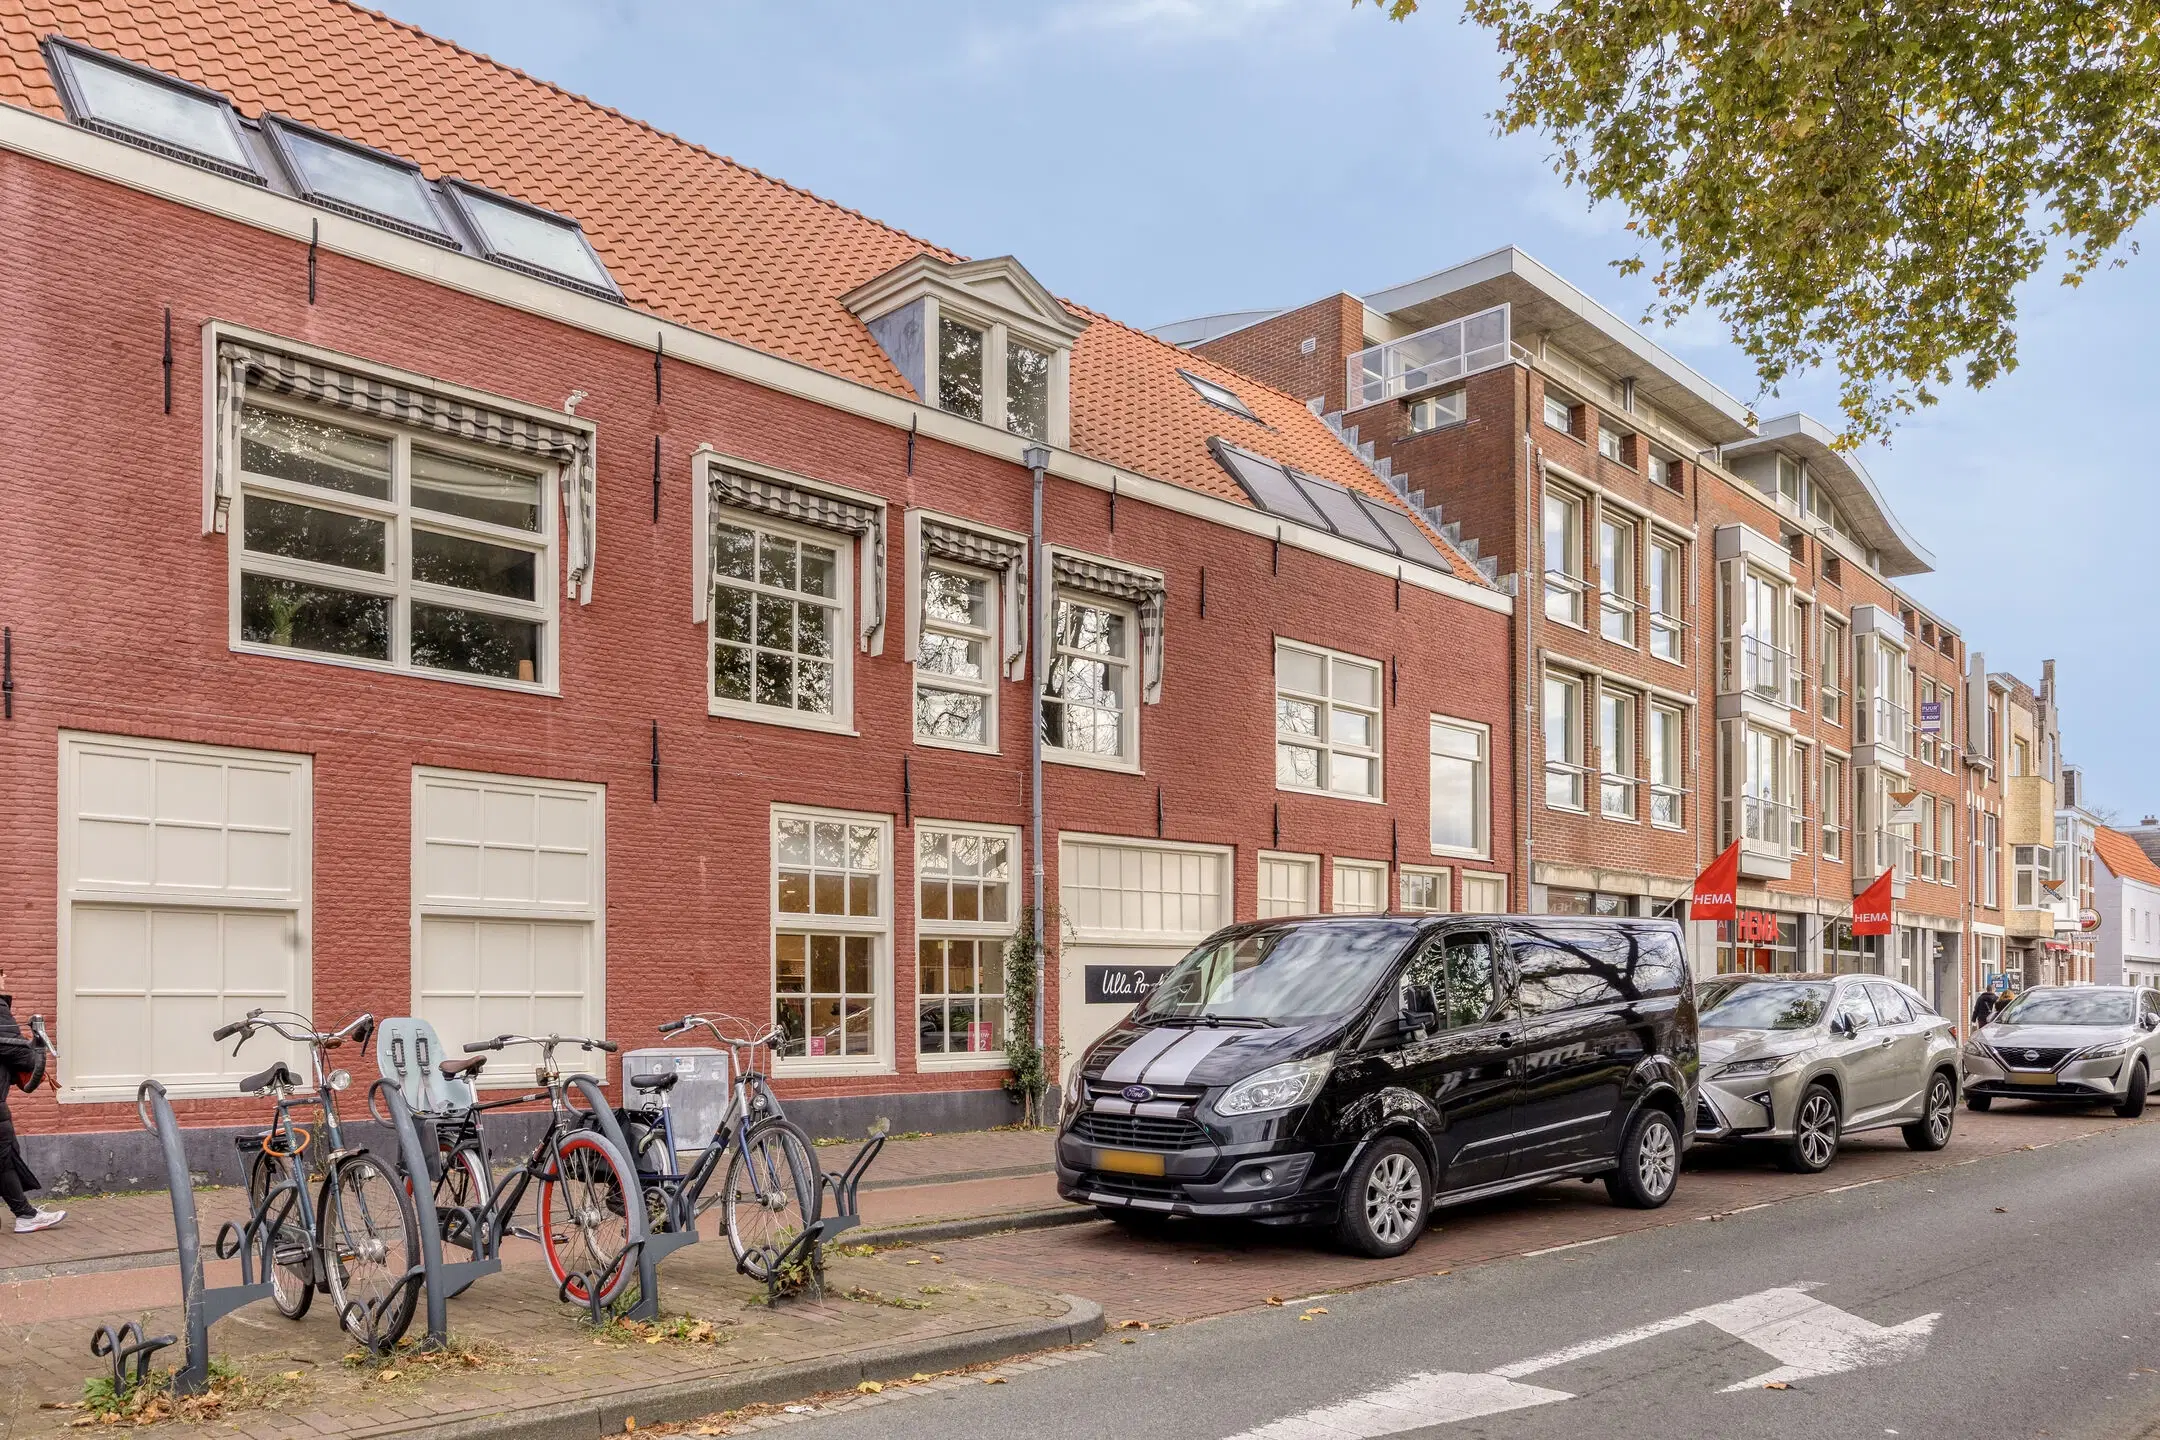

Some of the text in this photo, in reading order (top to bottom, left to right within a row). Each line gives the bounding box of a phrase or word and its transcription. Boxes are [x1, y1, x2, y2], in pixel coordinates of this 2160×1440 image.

[1693, 893, 1733, 905] HEMA
[1854, 912, 1889, 923] HEMA
[1737, 910, 1779, 942] HEMA
[1102, 969, 1132, 994] Ulla
[1126, 1089, 1146, 1099] Ford
